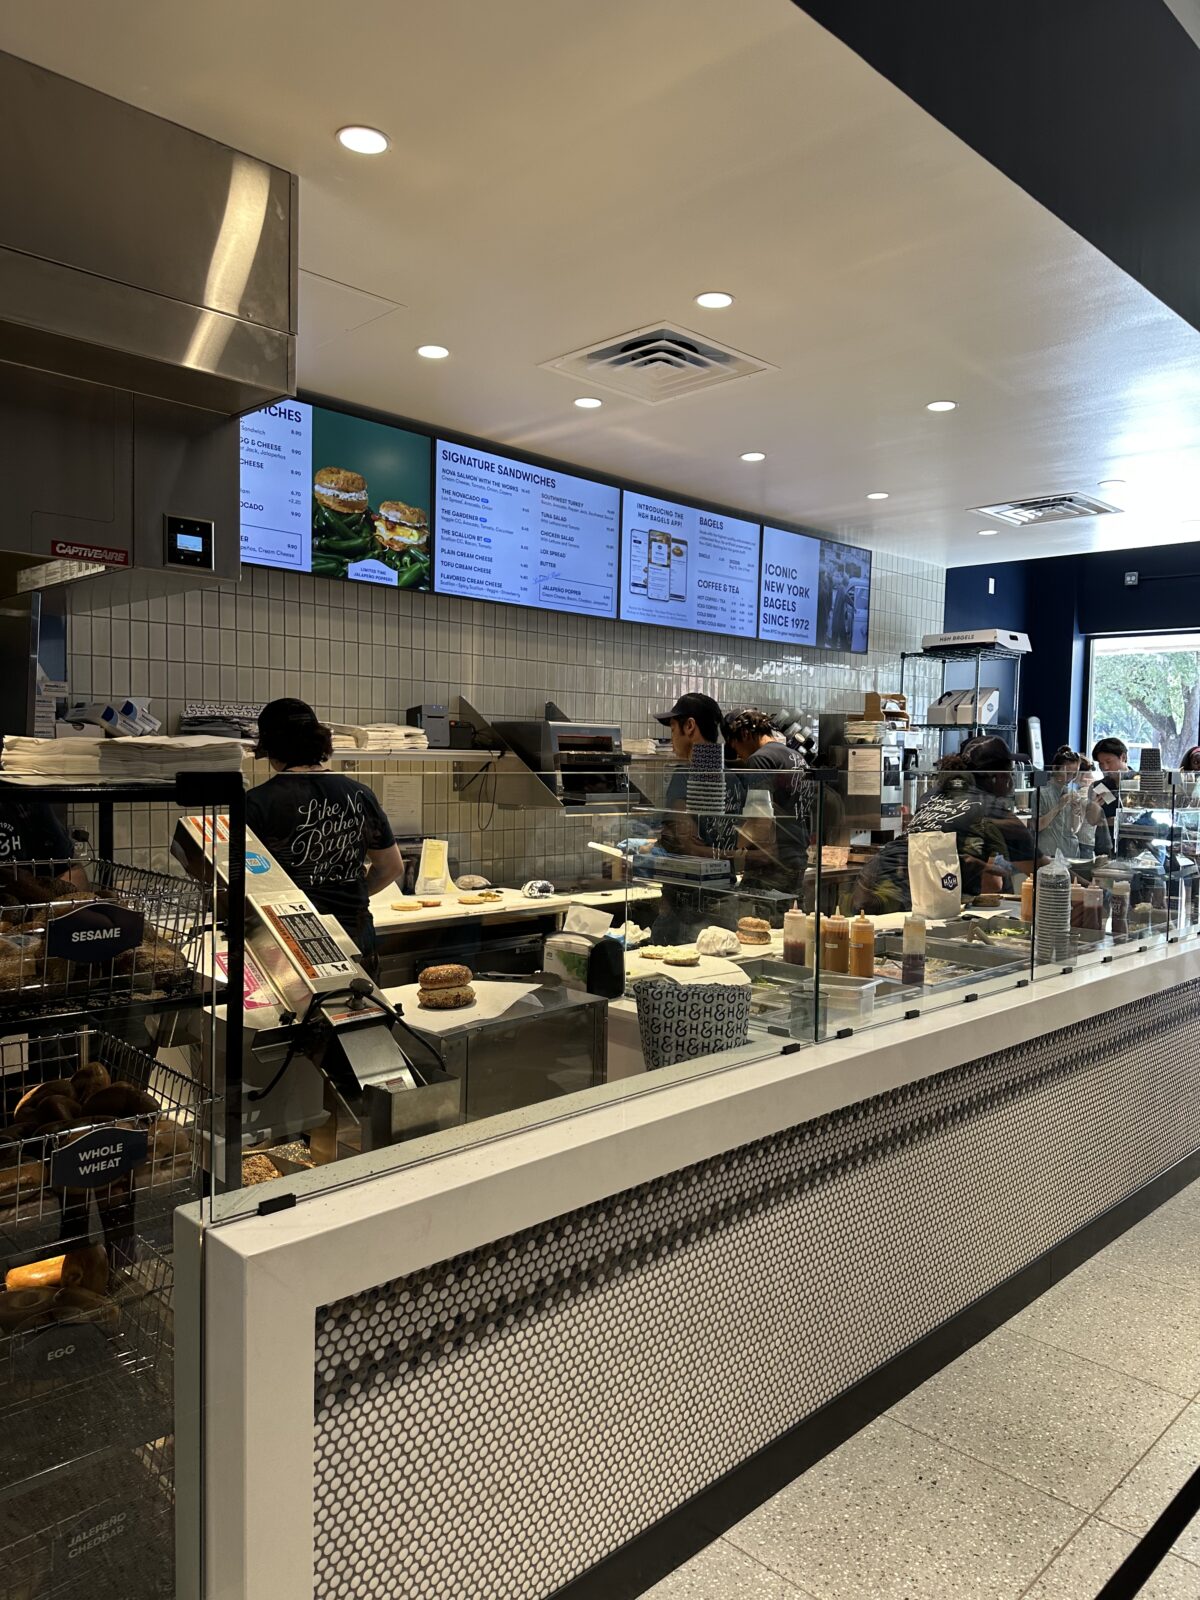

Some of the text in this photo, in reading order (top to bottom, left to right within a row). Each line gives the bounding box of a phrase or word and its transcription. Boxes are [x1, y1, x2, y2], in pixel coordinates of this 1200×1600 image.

[257, 440, 282, 452] CHEESE
[442, 449, 557, 489] SIGNATURE SANDWICHES
[442, 468, 456, 476] NOVA
[457, 471, 478, 482] SALMON
[478, 477, 492, 485] WITH
[502, 482, 519, 492] WORKS
[441, 488, 451, 496] THE
[452, 490, 480, 502] NOVACADO
[541, 493, 584, 508] SOUTHWEST TURKEY
[452, 510, 479, 521] GARDENER
[541, 511, 567, 522] TUNA SALAD
[636, 502, 674, 517] INTRODUCING
[650, 513, 670, 525] BAGELS
[699, 517, 724, 530] BAGELS
[451, 529, 476, 541] SCALLION
[540, 530, 575, 542] CHICKEN SALAD
[55, 543, 126, 562] CAPTIVEAIRE
[441, 547, 493, 562] PLAIN CREAM CHEESE
[549, 550, 566, 559] SPREAD
[441, 560, 492, 574] TOFU CREAM CHEESE
[765, 562, 798, 580] ICONIC
[440, 573, 503, 588] FLAVORED CREAM CHEESE
[697, 579, 740, 594] COFFEE & TEA
[565, 588, 581, 596] POPPER
[764, 579, 810, 599] NEW YORK
[763, 596, 797, 612] BAGELS
[762, 612, 789, 627] SINCE
[791, 617, 810, 630] 1972
[296, 798, 341, 831] Like
[340, 790, 364, 817] No
[321, 811, 360, 837] Other
[291, 815, 365, 866] Bagel
[313, 861, 330, 874] in
[943, 876, 957, 888] H&H
[71, 927, 121, 942] SESAME
[78, 1142, 123, 1161] WHOLE
[78, 1156, 122, 1175] WHEAT
[47, 1344, 76, 1361] EGG
[68, 1525, 125, 1558] CHEDDAR
